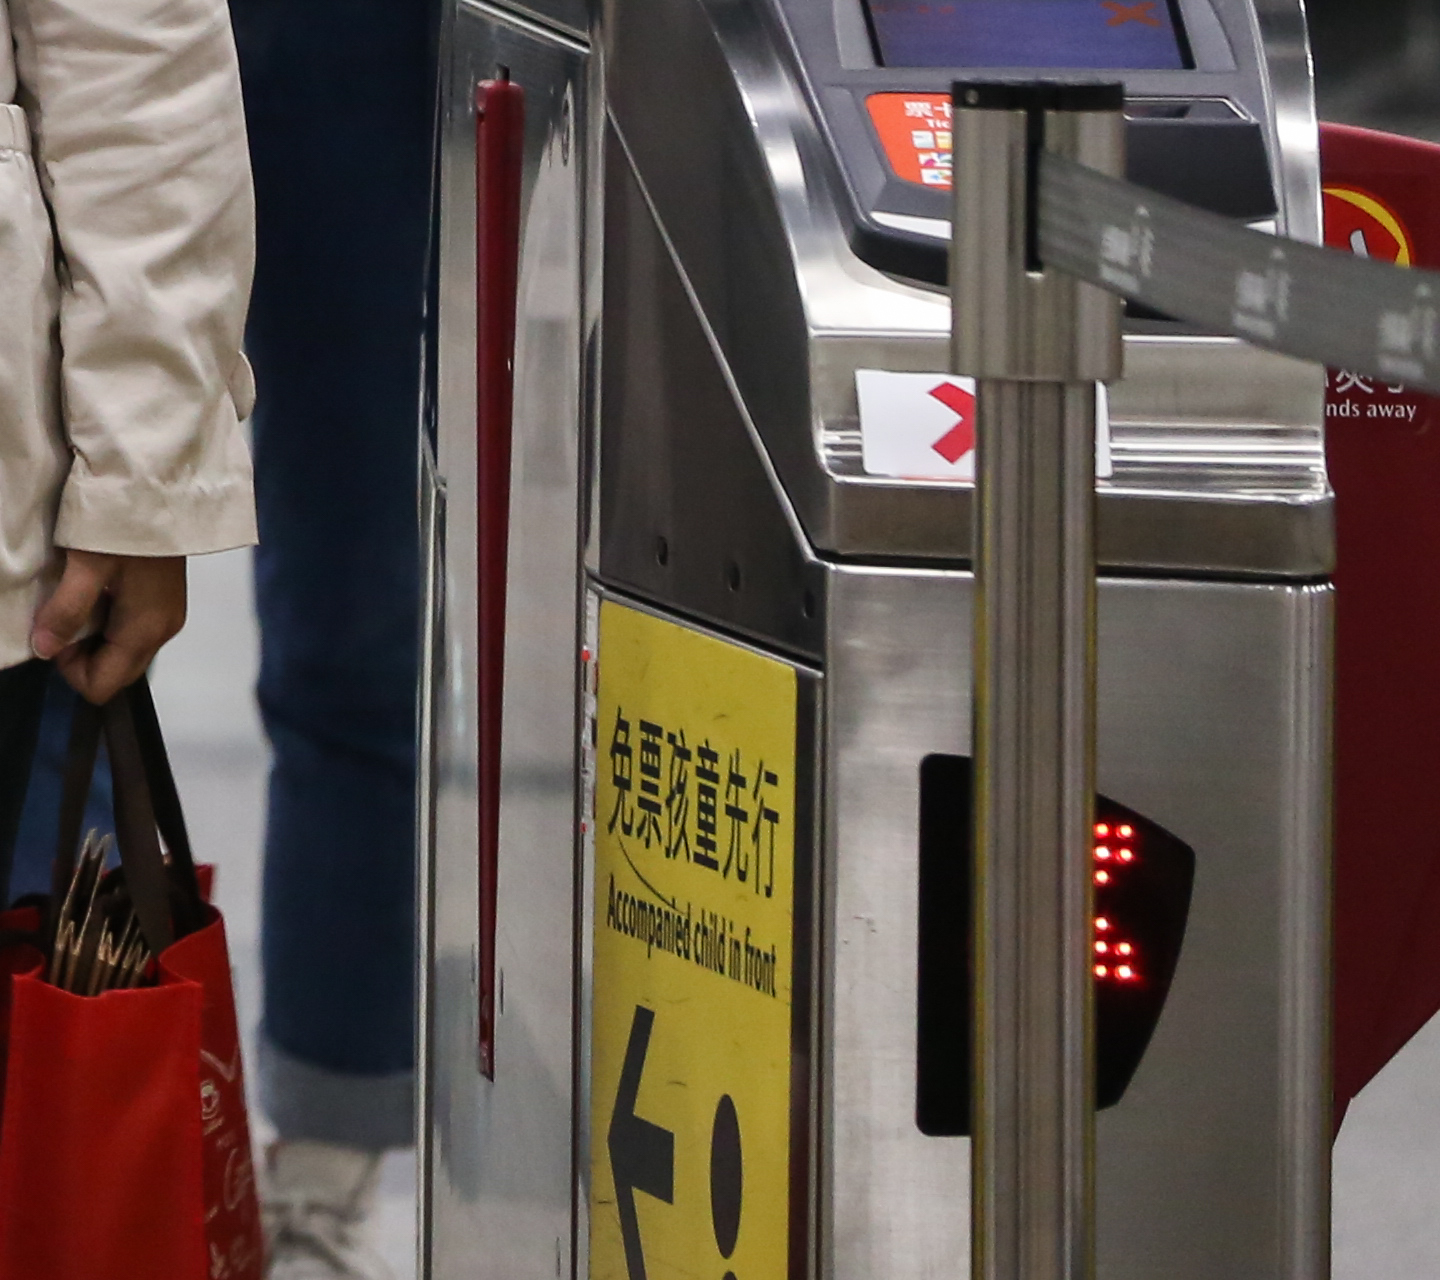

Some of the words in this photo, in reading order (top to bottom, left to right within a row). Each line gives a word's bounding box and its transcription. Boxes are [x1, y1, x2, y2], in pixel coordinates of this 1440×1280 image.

[1366, 403, 1417, 423] away
[608, 705, 779, 898] 免票孩童先行
[607, 872, 691, 960] Accompanied
[694, 908, 726, 977] child
[729, 920, 742, 982] in
[745, 926, 777, 998] front
